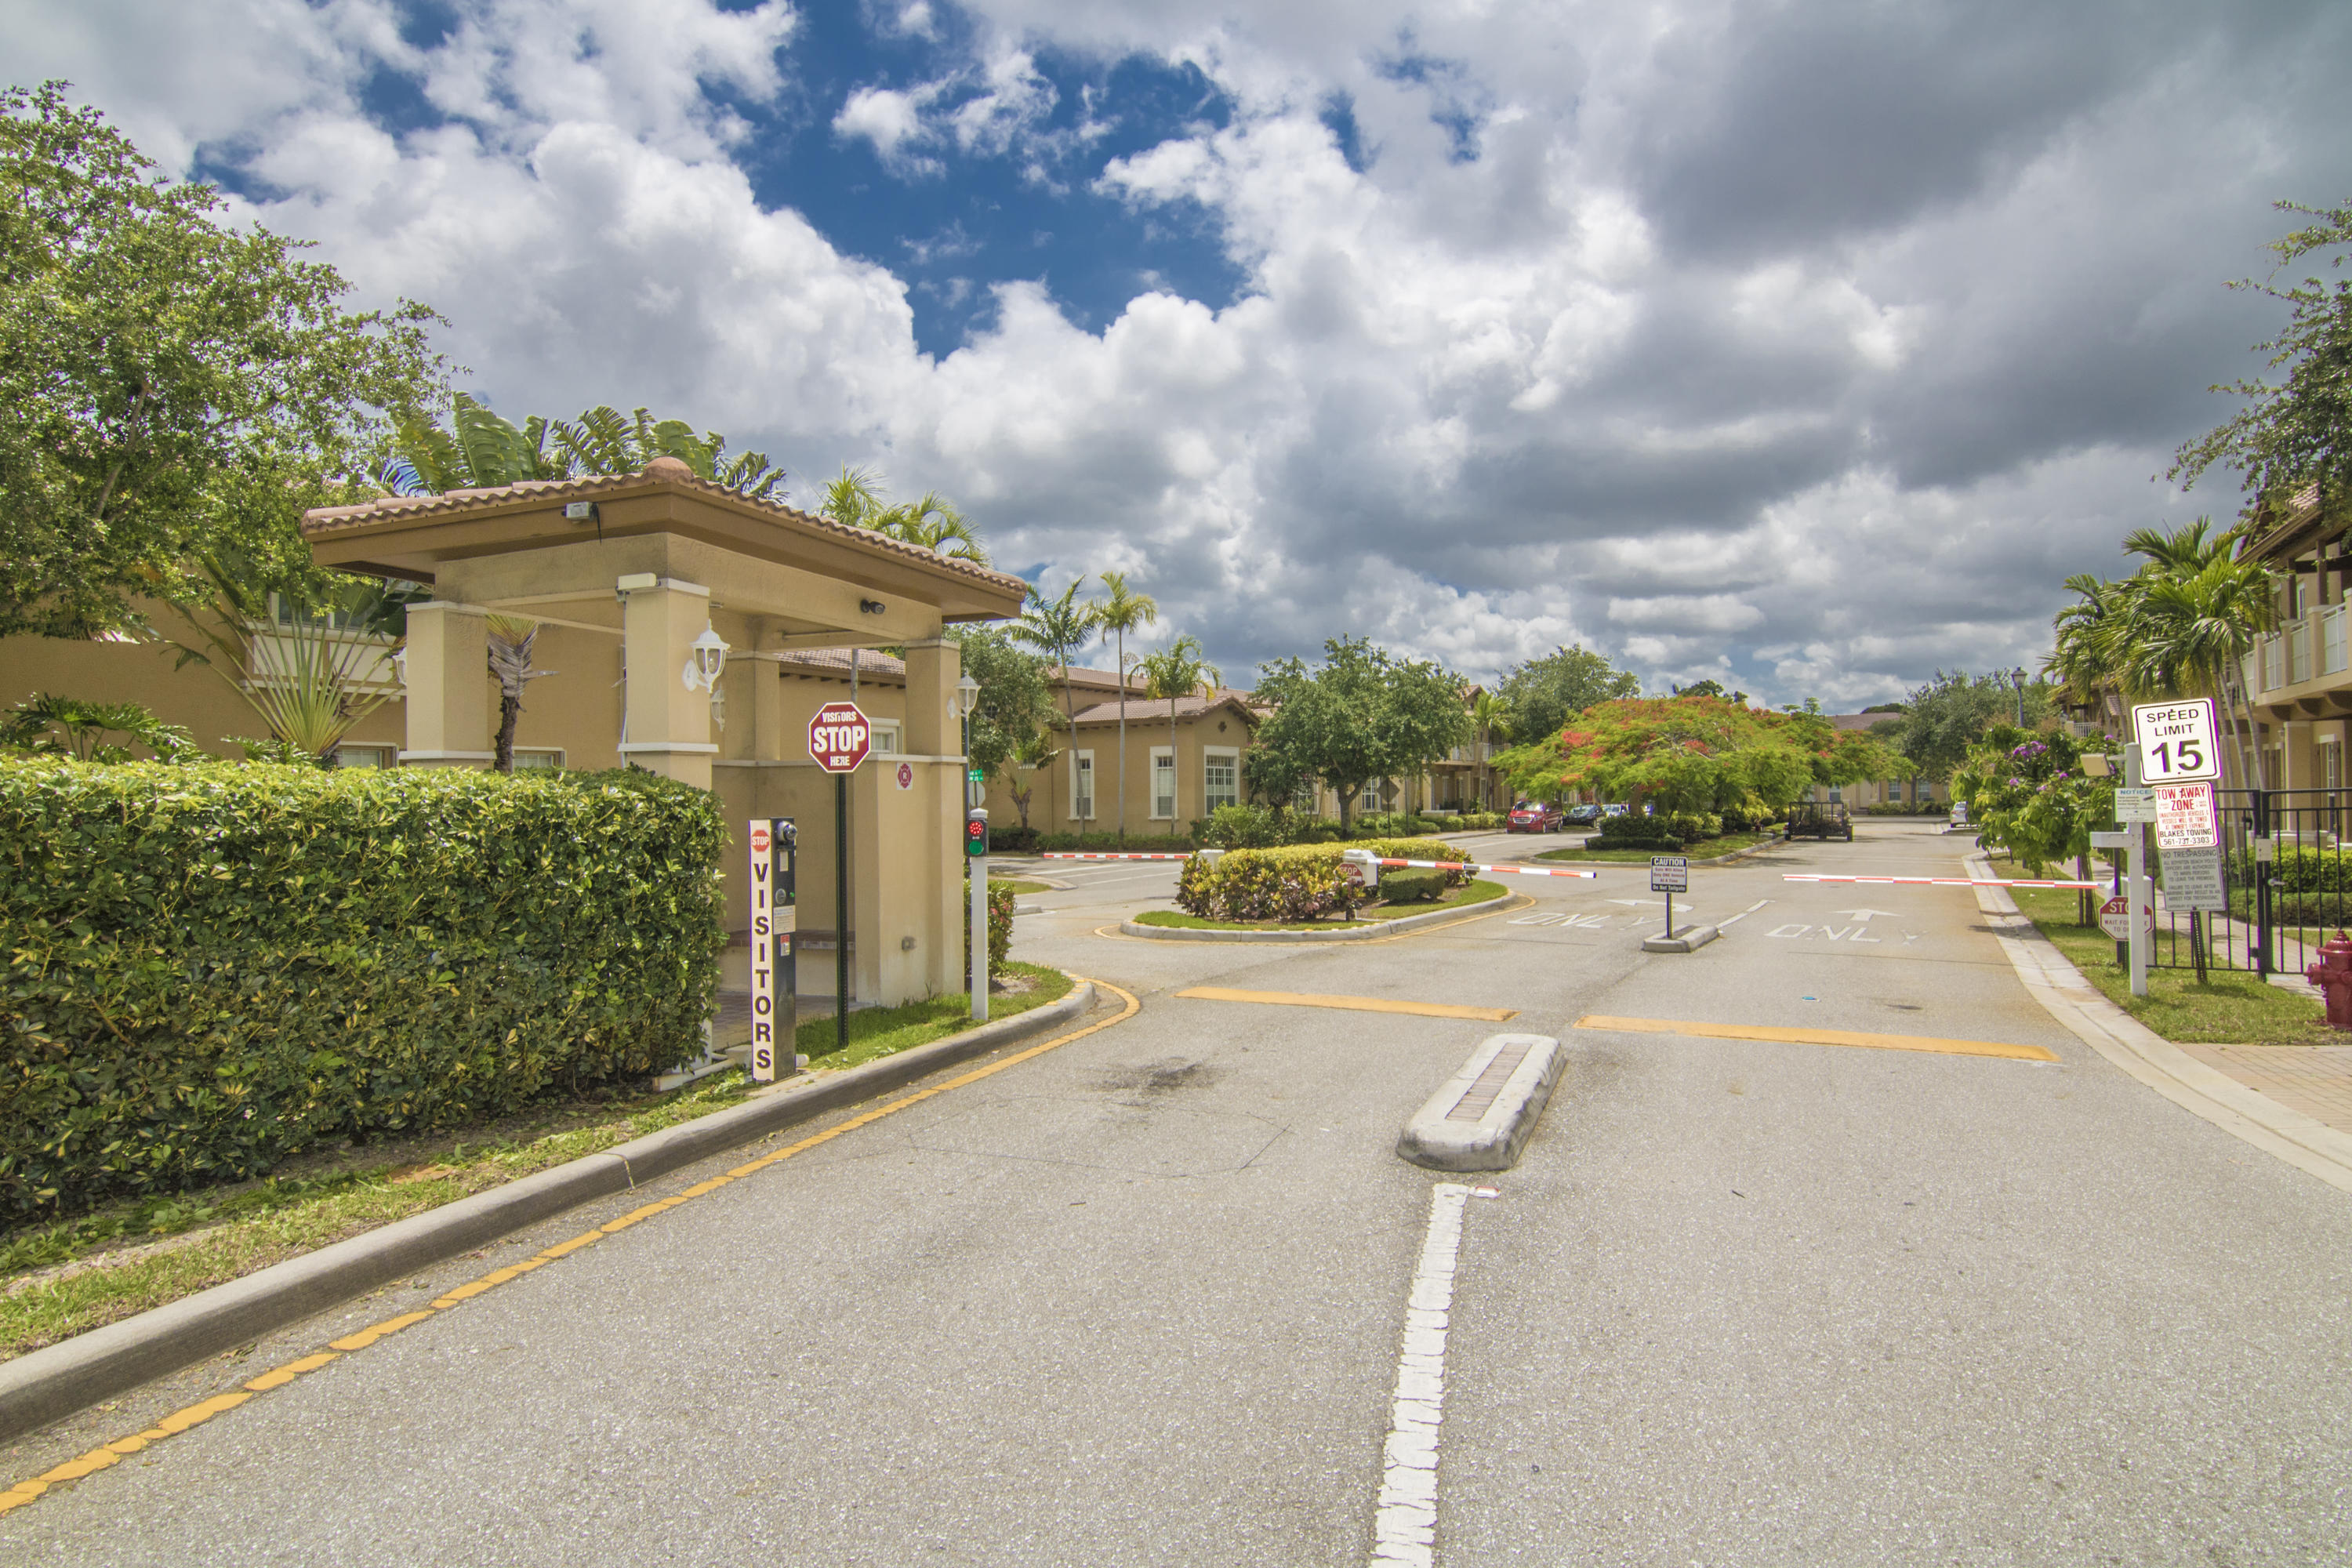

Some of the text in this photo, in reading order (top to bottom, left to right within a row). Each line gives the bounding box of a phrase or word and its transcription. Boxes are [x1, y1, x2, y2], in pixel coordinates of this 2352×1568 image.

[822, 711, 856, 723] VISITORS
[2147, 710, 2198, 723] SPEED
[2154, 724, 2194, 736] LIMIT
[813, 725, 866, 753] STOP
[829, 756, 850, 766] HERE
[2151, 739, 2203, 773] 15
[2156, 786, 2205, 800] TOW AWAY
[2171, 799, 2194, 811] ZONE
[752, 836, 770, 846] STOP
[2173, 849, 2217, 858] TRESPASSING
[2109, 902, 2130, 913] STO
[1506, 913, 1666, 931] ONLY
[753, 863, 771, 1069] VISITORS
